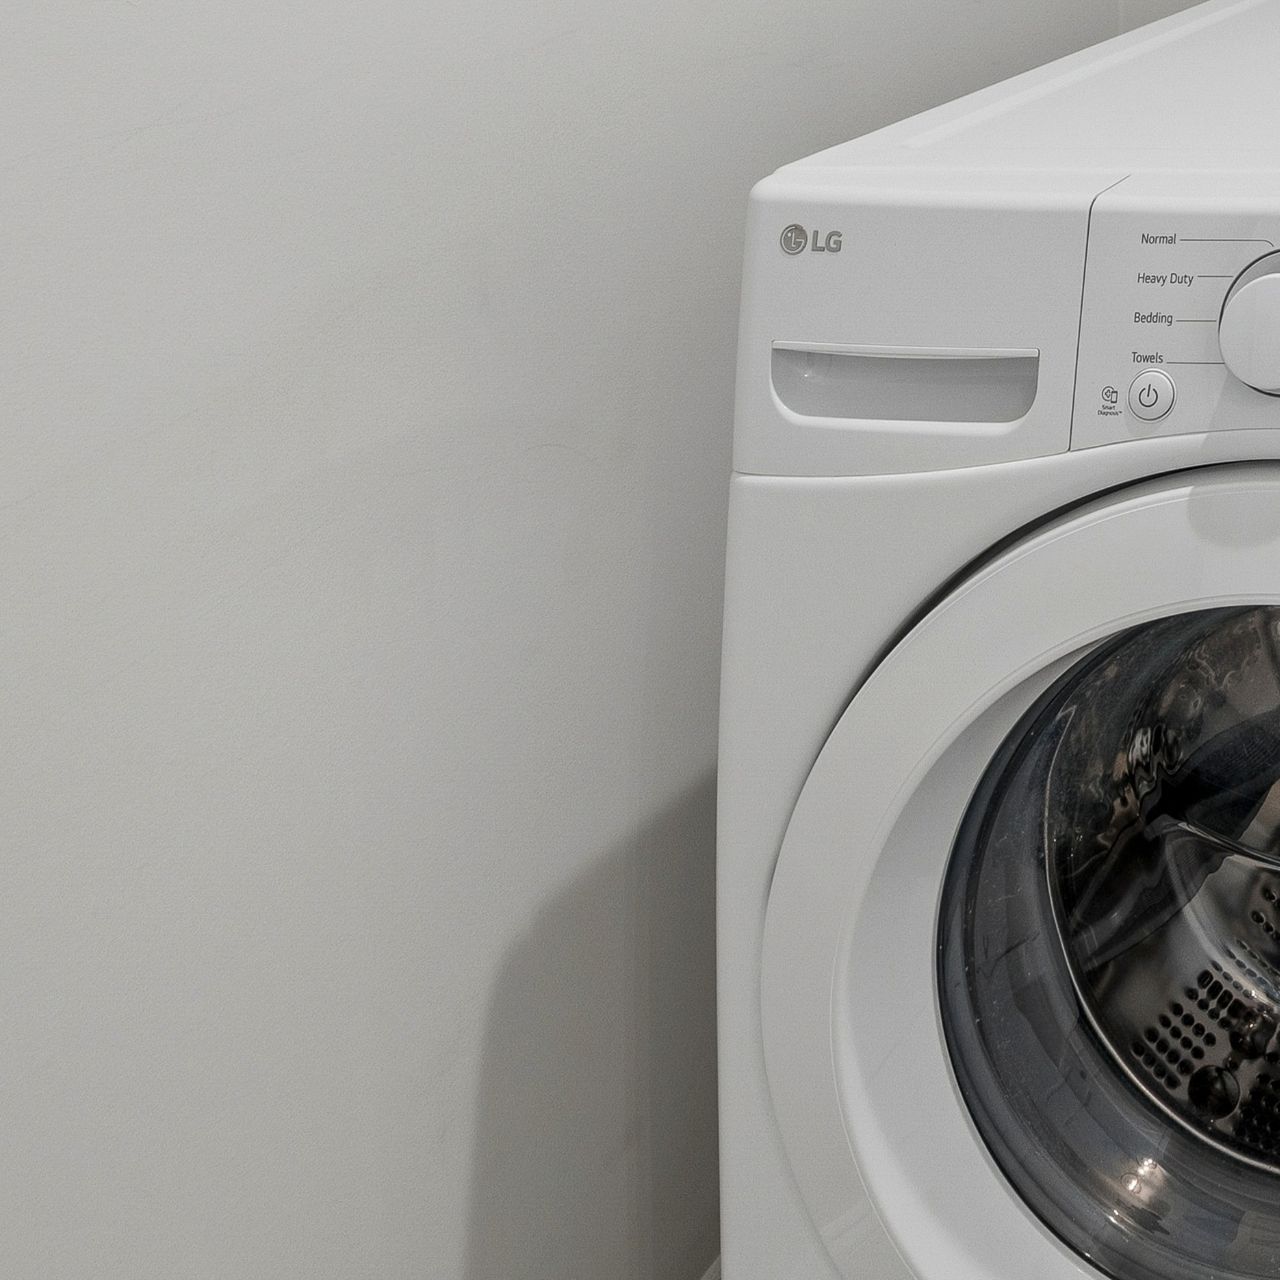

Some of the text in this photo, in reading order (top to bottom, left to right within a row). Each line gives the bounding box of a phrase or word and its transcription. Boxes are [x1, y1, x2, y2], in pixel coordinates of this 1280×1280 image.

[811, 230, 842, 252] LG
[1141, 234, 1176, 245] Normal
[1137, 273, 1193, 286] Heavy Duty
[1134, 313, 1173, 326] Bedding
[1132, 352, 1163, 364] Towels
